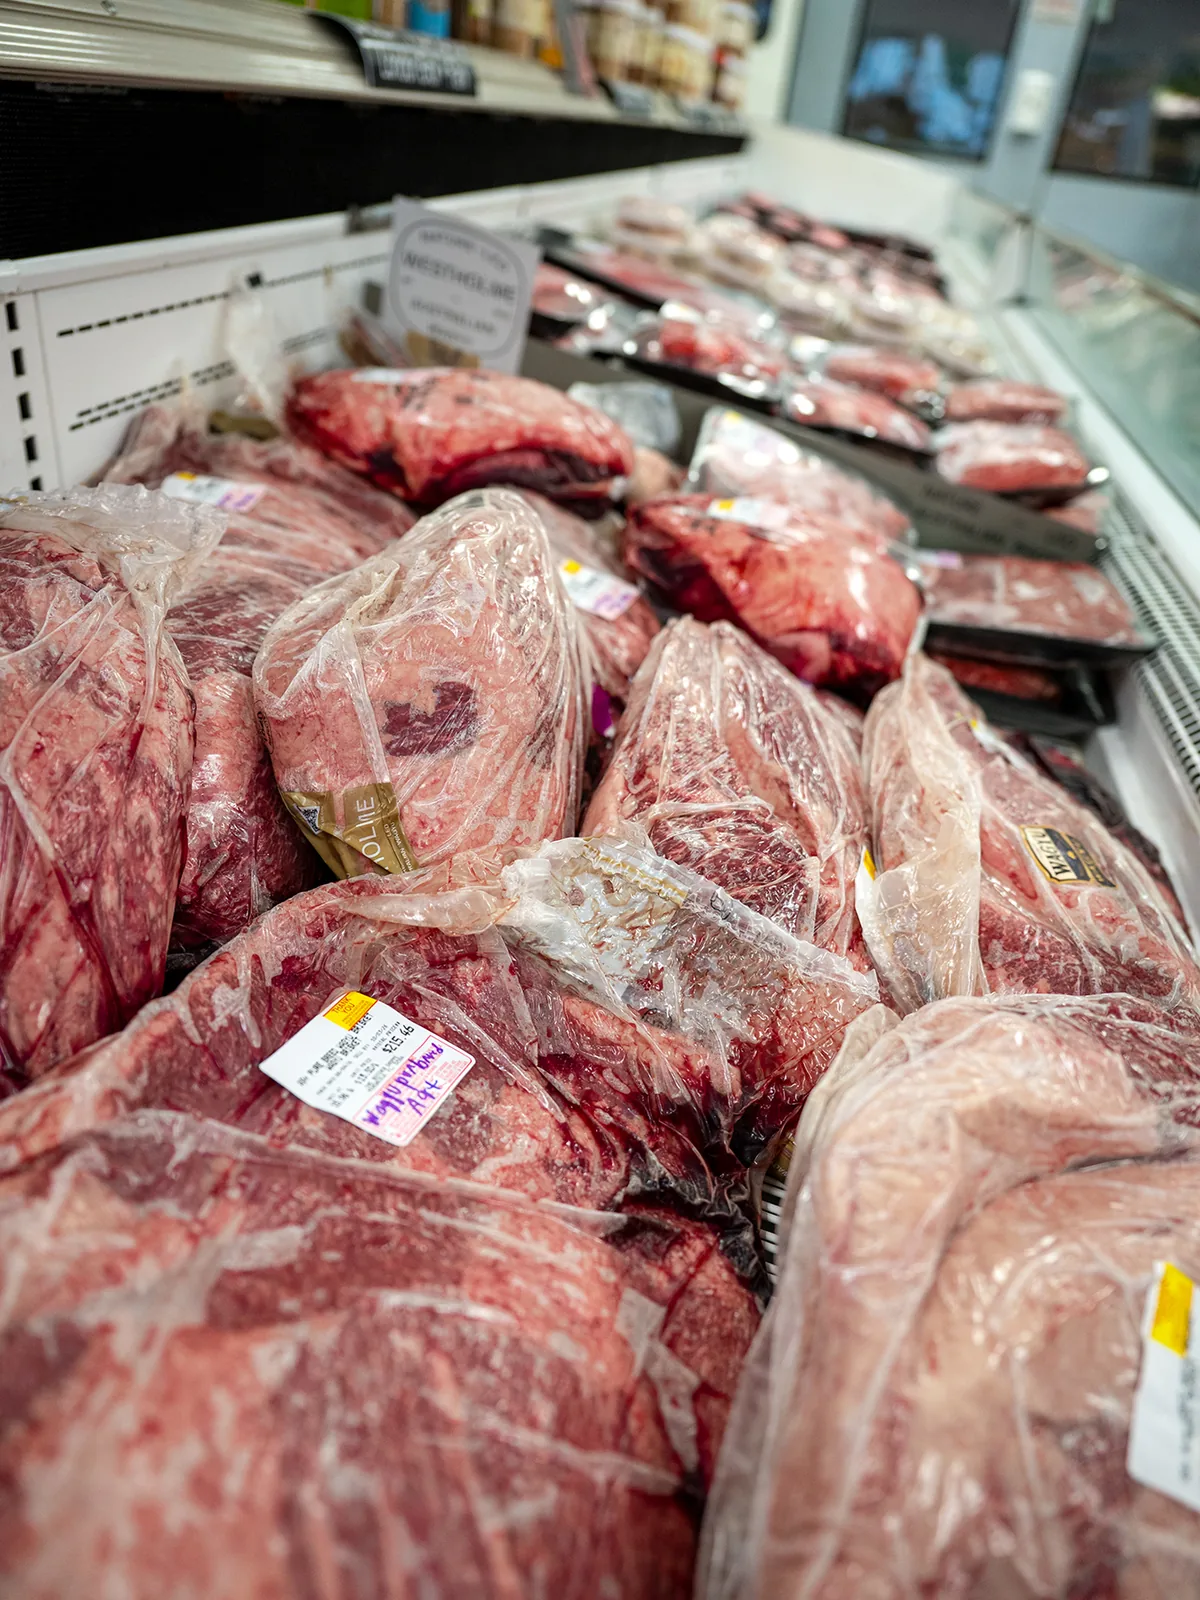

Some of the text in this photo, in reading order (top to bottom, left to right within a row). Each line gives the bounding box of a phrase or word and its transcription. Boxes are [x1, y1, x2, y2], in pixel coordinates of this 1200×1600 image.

[1031, 831, 1071, 876] WAGYU
[332, 998, 351, 1014] THANK
[342, 1003, 355, 1014] YOU
[340, 1037, 362, 1056] BRISKET
[382, 1024, 415, 1053] $215.46
